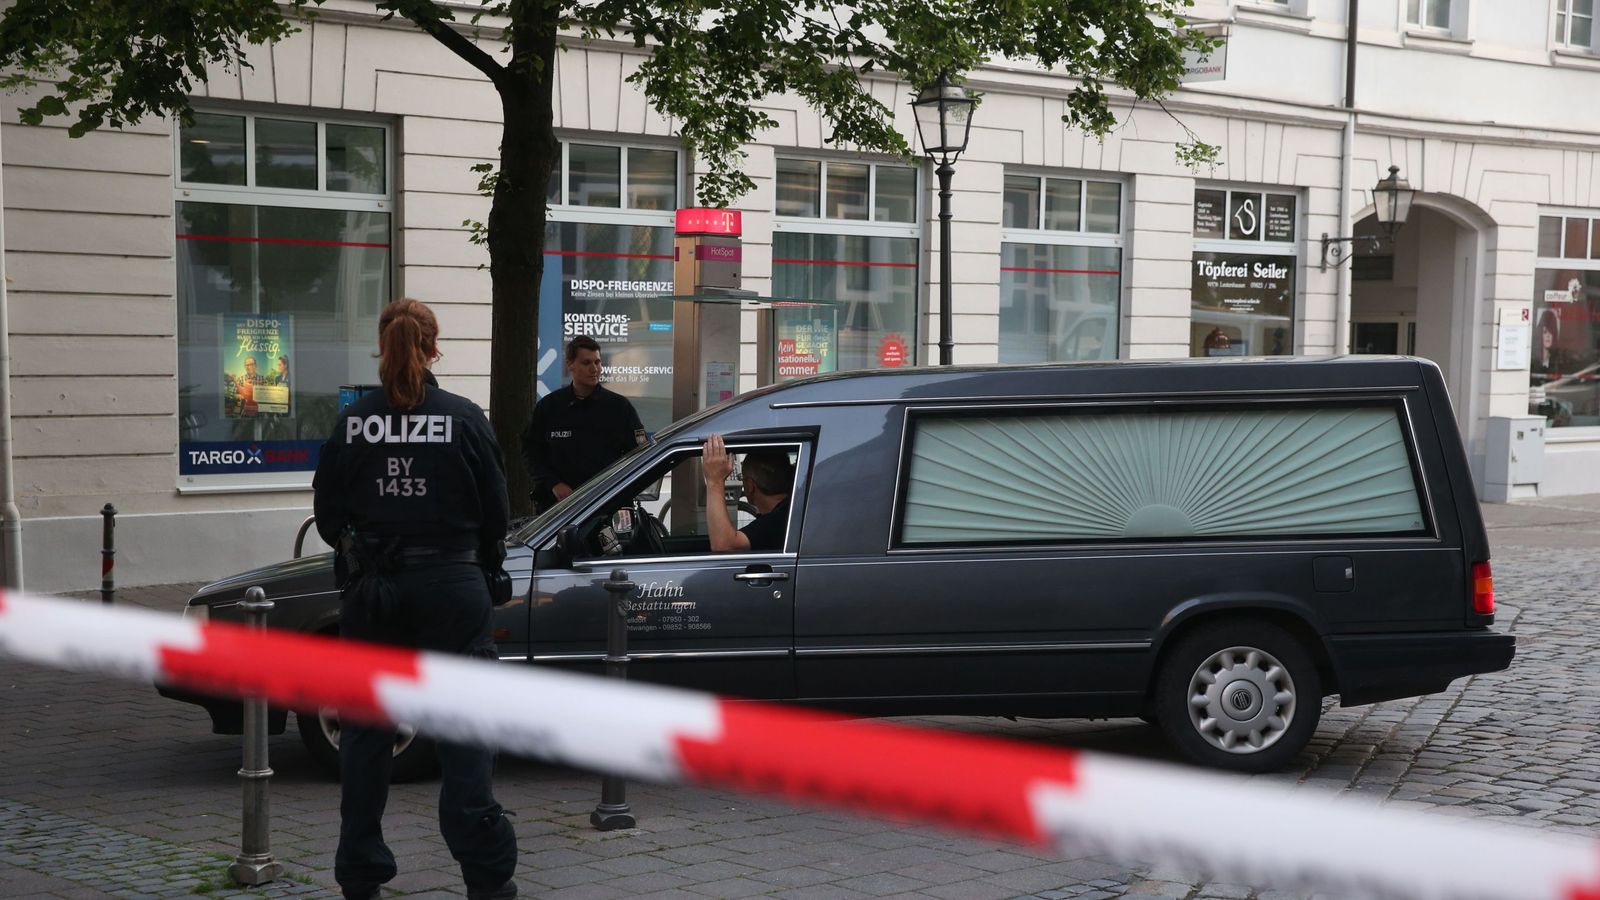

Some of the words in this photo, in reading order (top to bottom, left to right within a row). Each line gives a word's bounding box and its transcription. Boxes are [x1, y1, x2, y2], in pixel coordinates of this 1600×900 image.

[711, 248, 734, 256] HotSpot
[1197, 260, 1248, 280] Töpferei
[1253, 262, 1287, 279] Seiler
[571, 280, 674, 292] DISPO-FREIGRENZE
[247, 319, 281, 328] DISPO-
[564, 313, 631, 323] KONTO-SMS-
[564, 323, 628, 336] SERVICE
[346, 415, 452, 444] POLIZEI
[189, 450, 245, 465] TARGO
[387, 458, 414, 476] BY
[376, 478, 427, 497] 1433
[637, 580, 684, 598] Hahn
